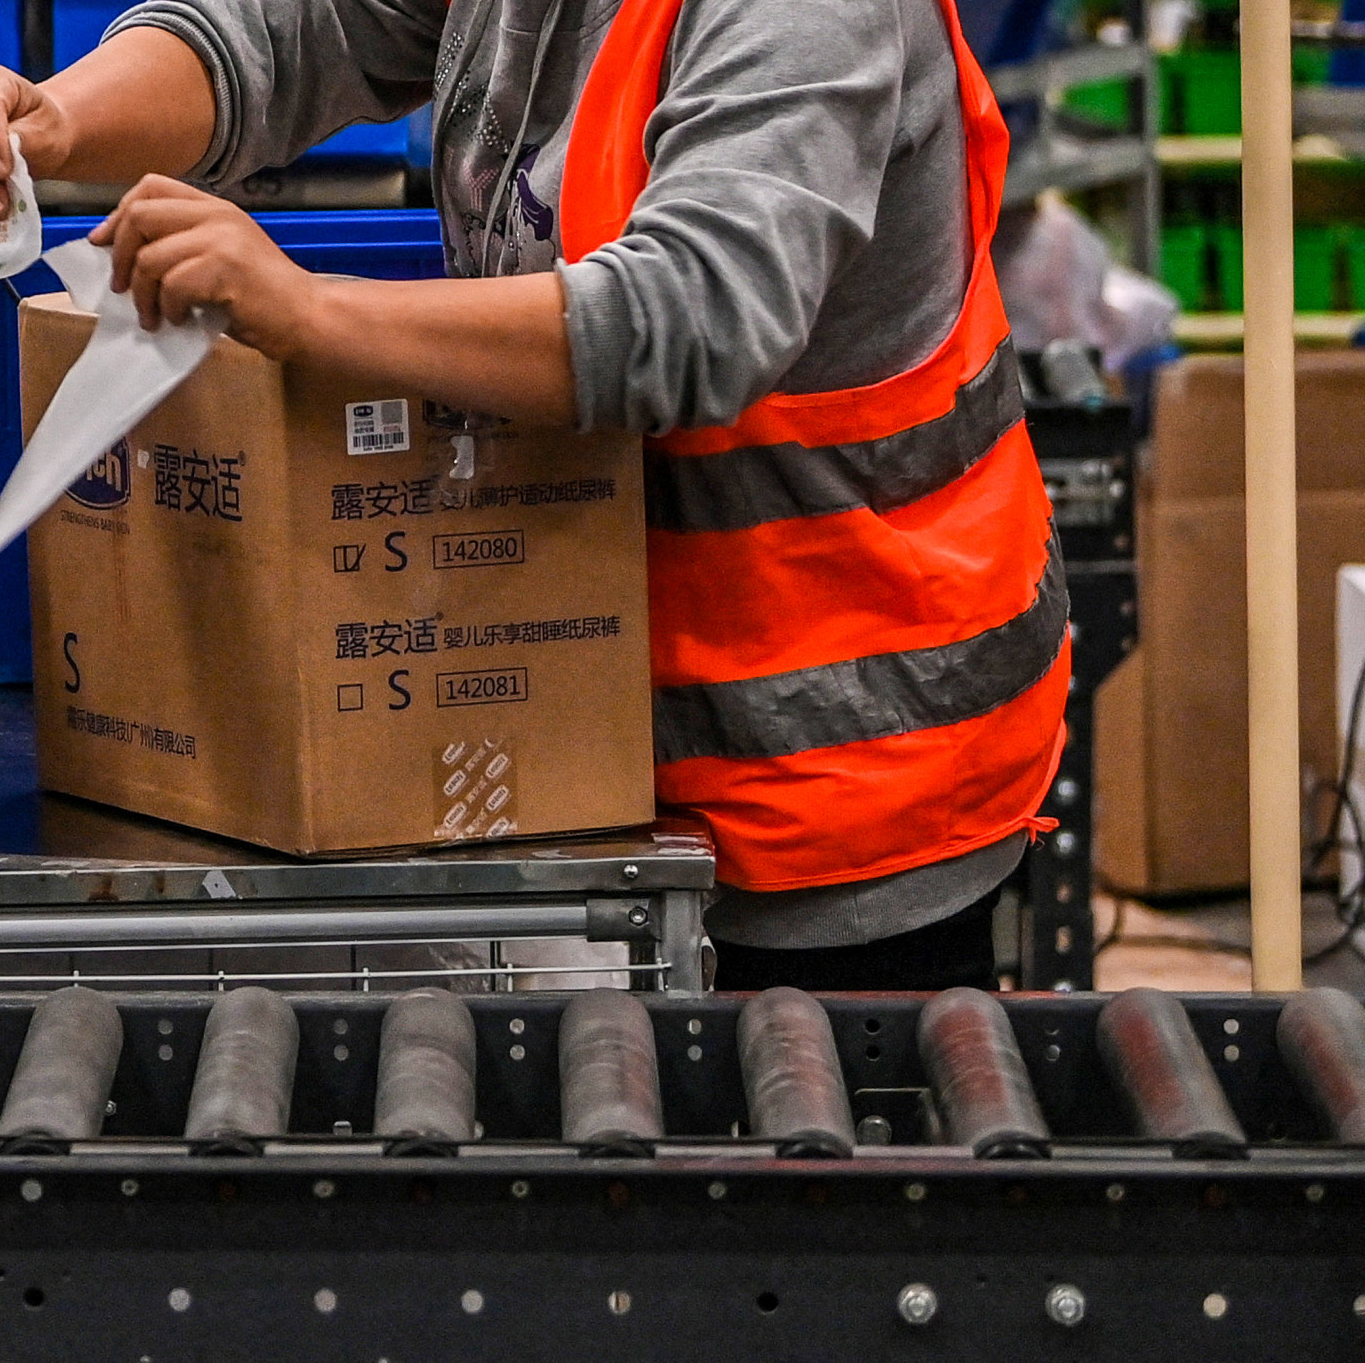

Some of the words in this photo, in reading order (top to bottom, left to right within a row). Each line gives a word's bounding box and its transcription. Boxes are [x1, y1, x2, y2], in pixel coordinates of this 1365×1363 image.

[153, 443, 243, 522] 露安适
[331, 478, 434, 521] 露安适
[384, 531, 408, 573] S
[442, 538, 518, 563] 142080
[335, 617, 438, 660] 露安适
[443, 615, 621, 649] 婴儿乐享甜睡纸尿裤
[63, 632, 80, 693] S
[388, 669, 412, 711] S
[445, 675, 521, 701] 142081
